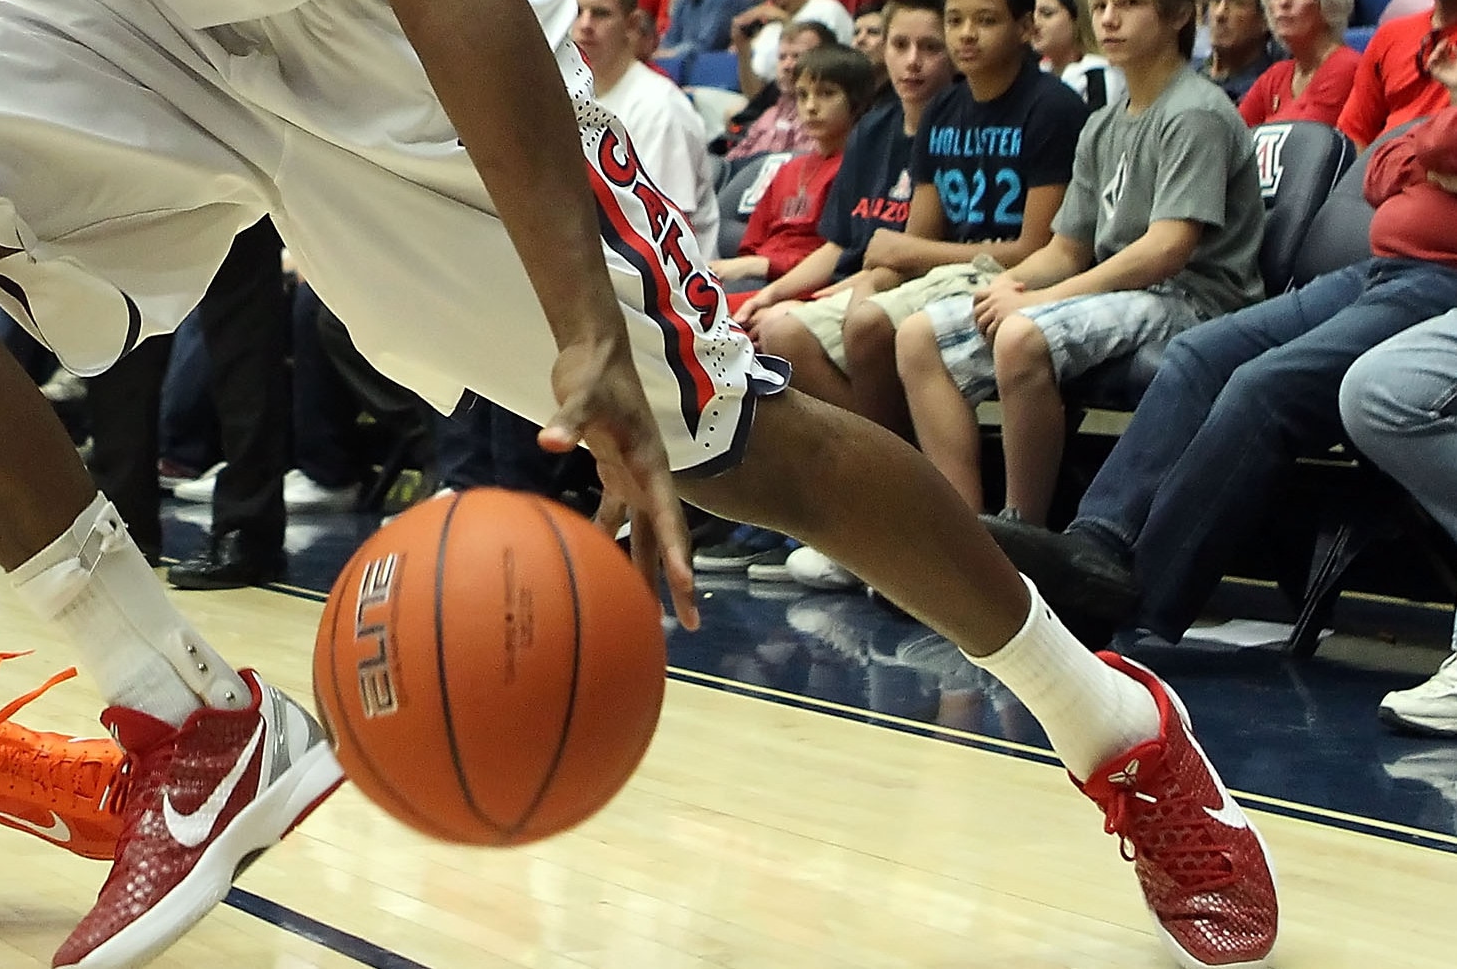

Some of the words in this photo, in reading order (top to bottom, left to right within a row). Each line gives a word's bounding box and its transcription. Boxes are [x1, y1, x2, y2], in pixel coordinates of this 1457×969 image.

[598, 127, 720, 333] CATS
[851, 196, 911, 223] AIZO
[933, 167, 1025, 225] 1922
[354, 551, 399, 719] ELITE
